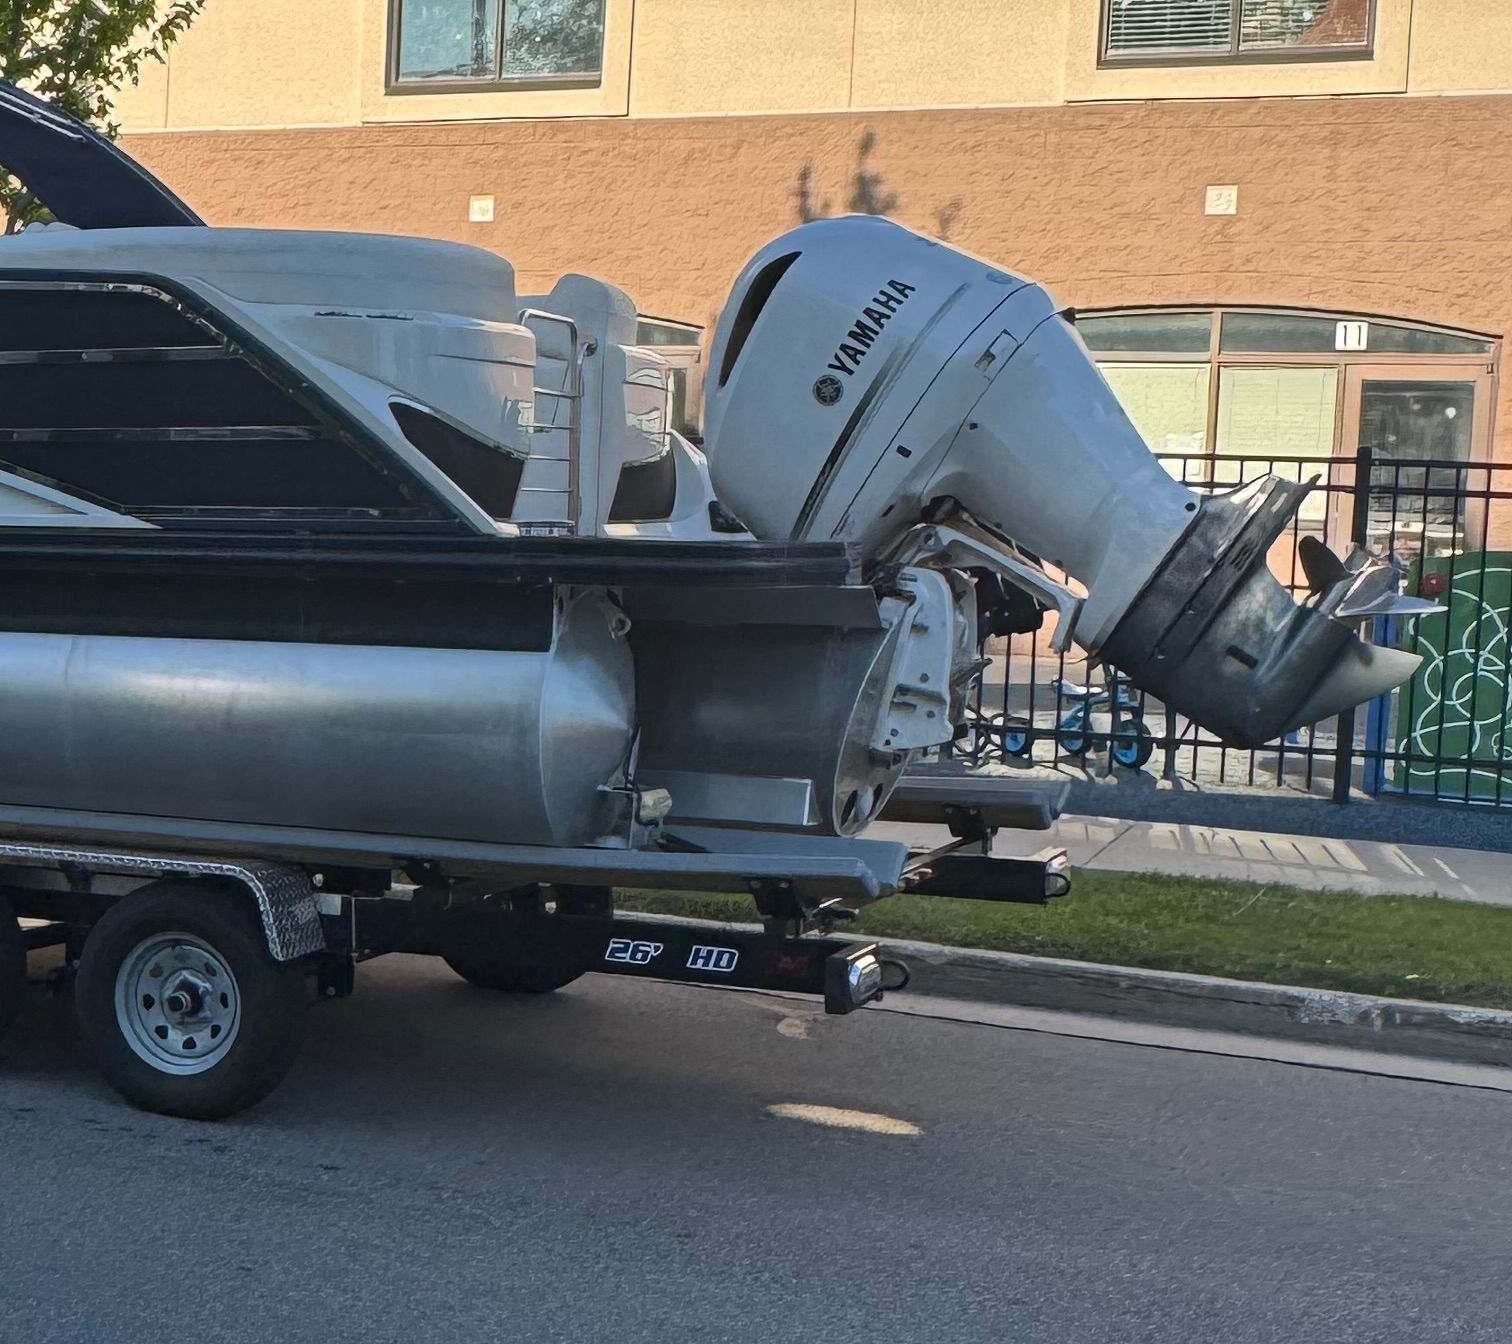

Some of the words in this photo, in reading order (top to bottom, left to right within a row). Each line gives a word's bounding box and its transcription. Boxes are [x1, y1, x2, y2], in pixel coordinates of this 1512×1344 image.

[827, 279, 916, 376] YAMAHA
[1343, 324, 1362, 347] 11
[604, 938, 664, 965] 26'
[686, 945, 739, 972] HD
